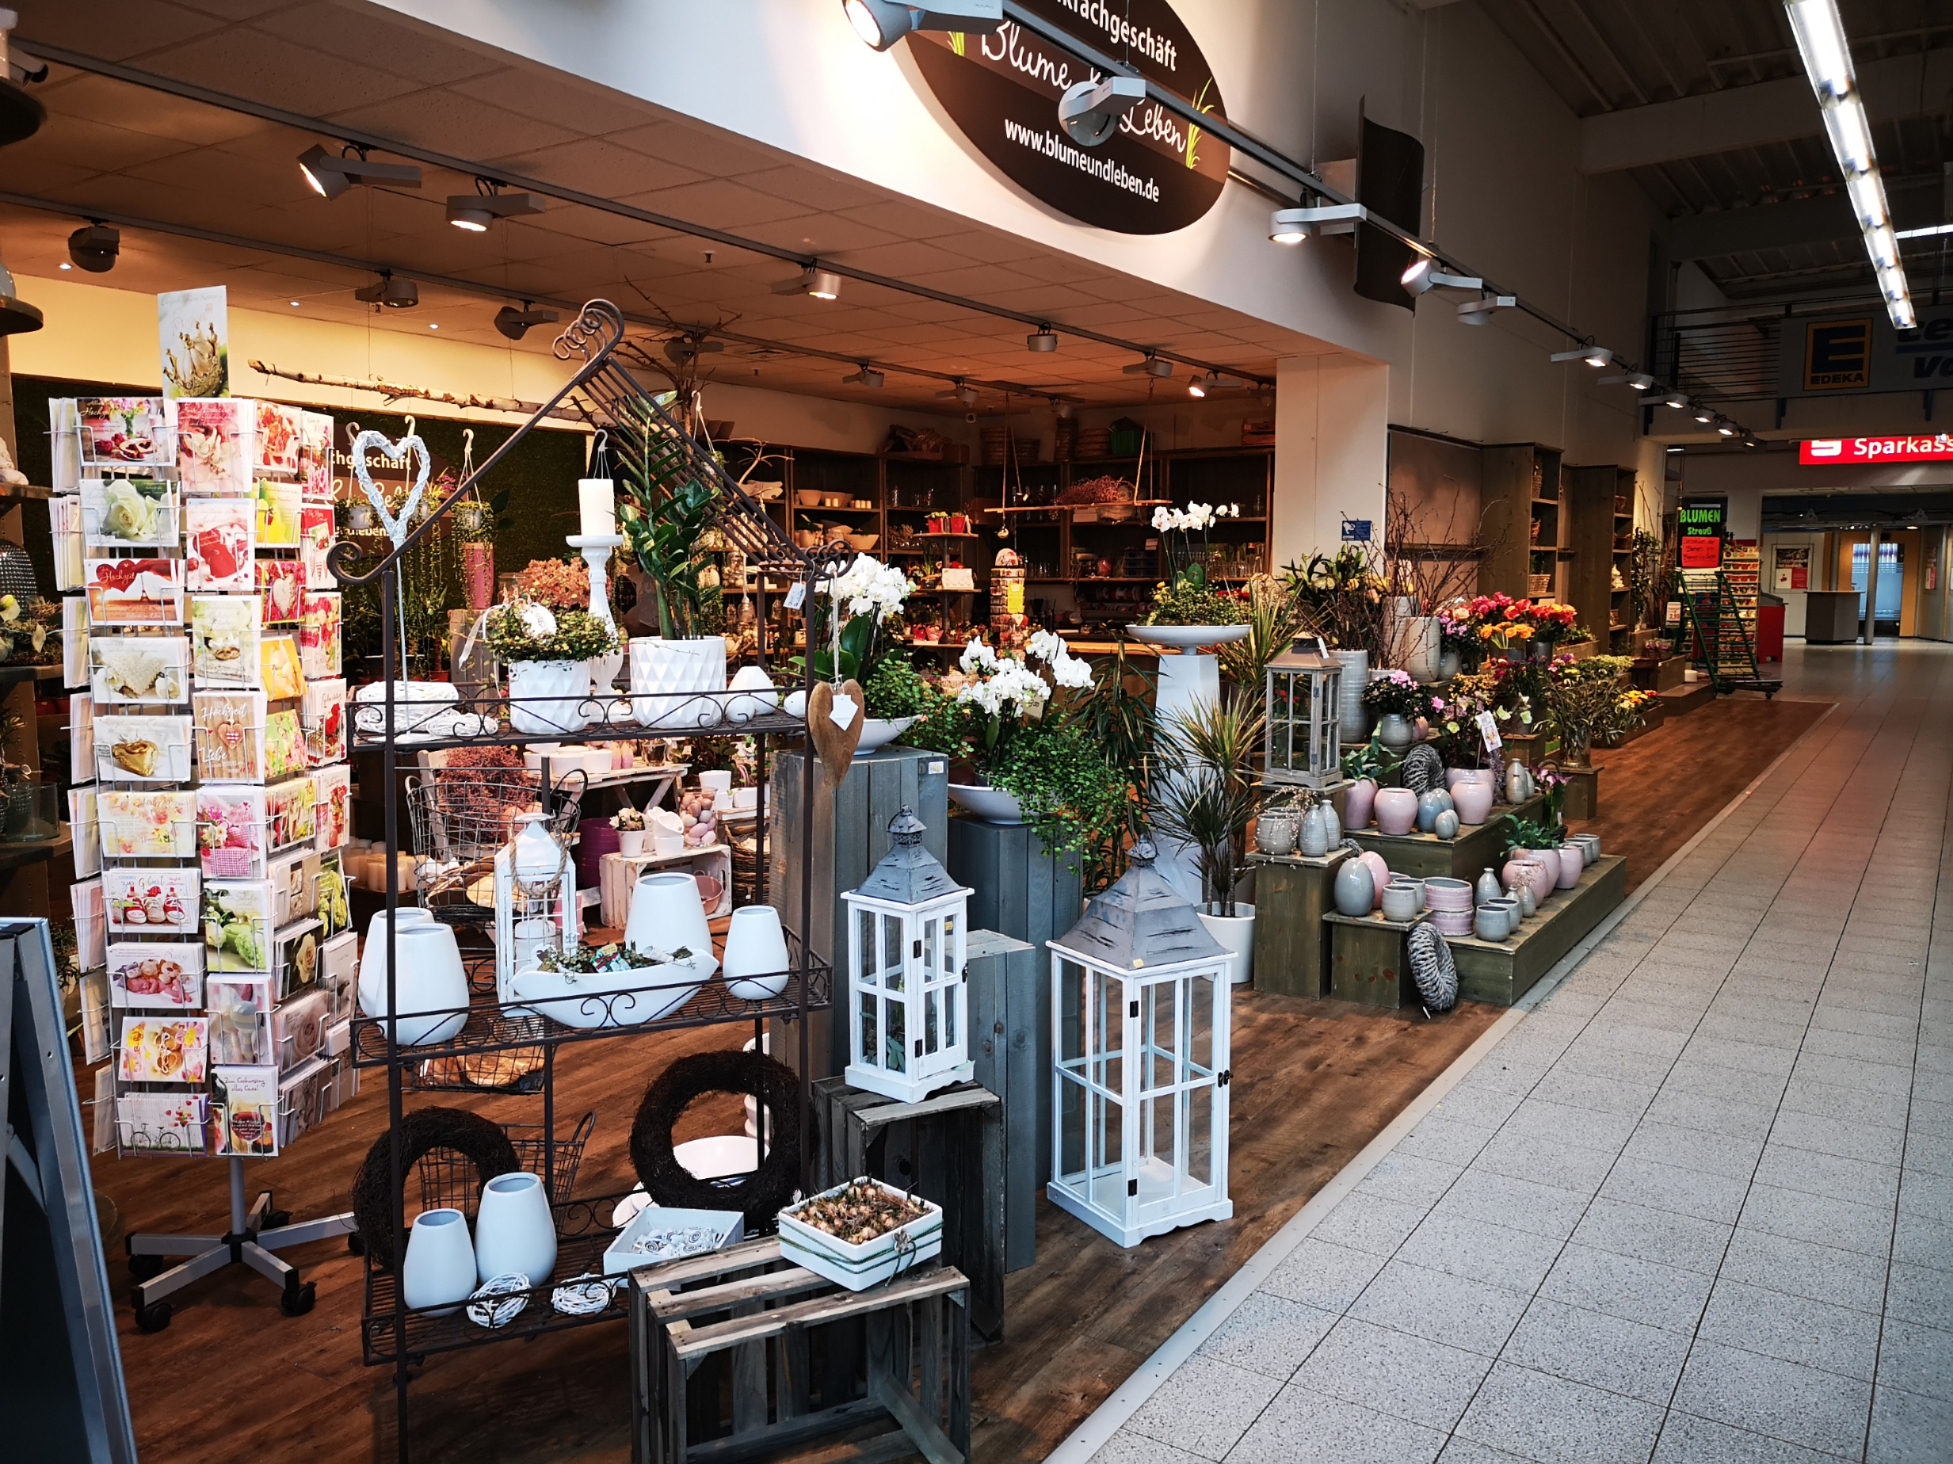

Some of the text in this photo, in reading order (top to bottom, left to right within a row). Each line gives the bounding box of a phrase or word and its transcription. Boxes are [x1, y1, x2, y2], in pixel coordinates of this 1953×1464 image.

[1004, 118, 1160, 203] www.blumeundleben.de
[1810, 373, 1864, 385] EDEKA
[1680, 509, 1721, 523] BLUMEN
[100, 571, 135, 585] Hochzeit
[201, 703, 248, 722] Hochzeit
